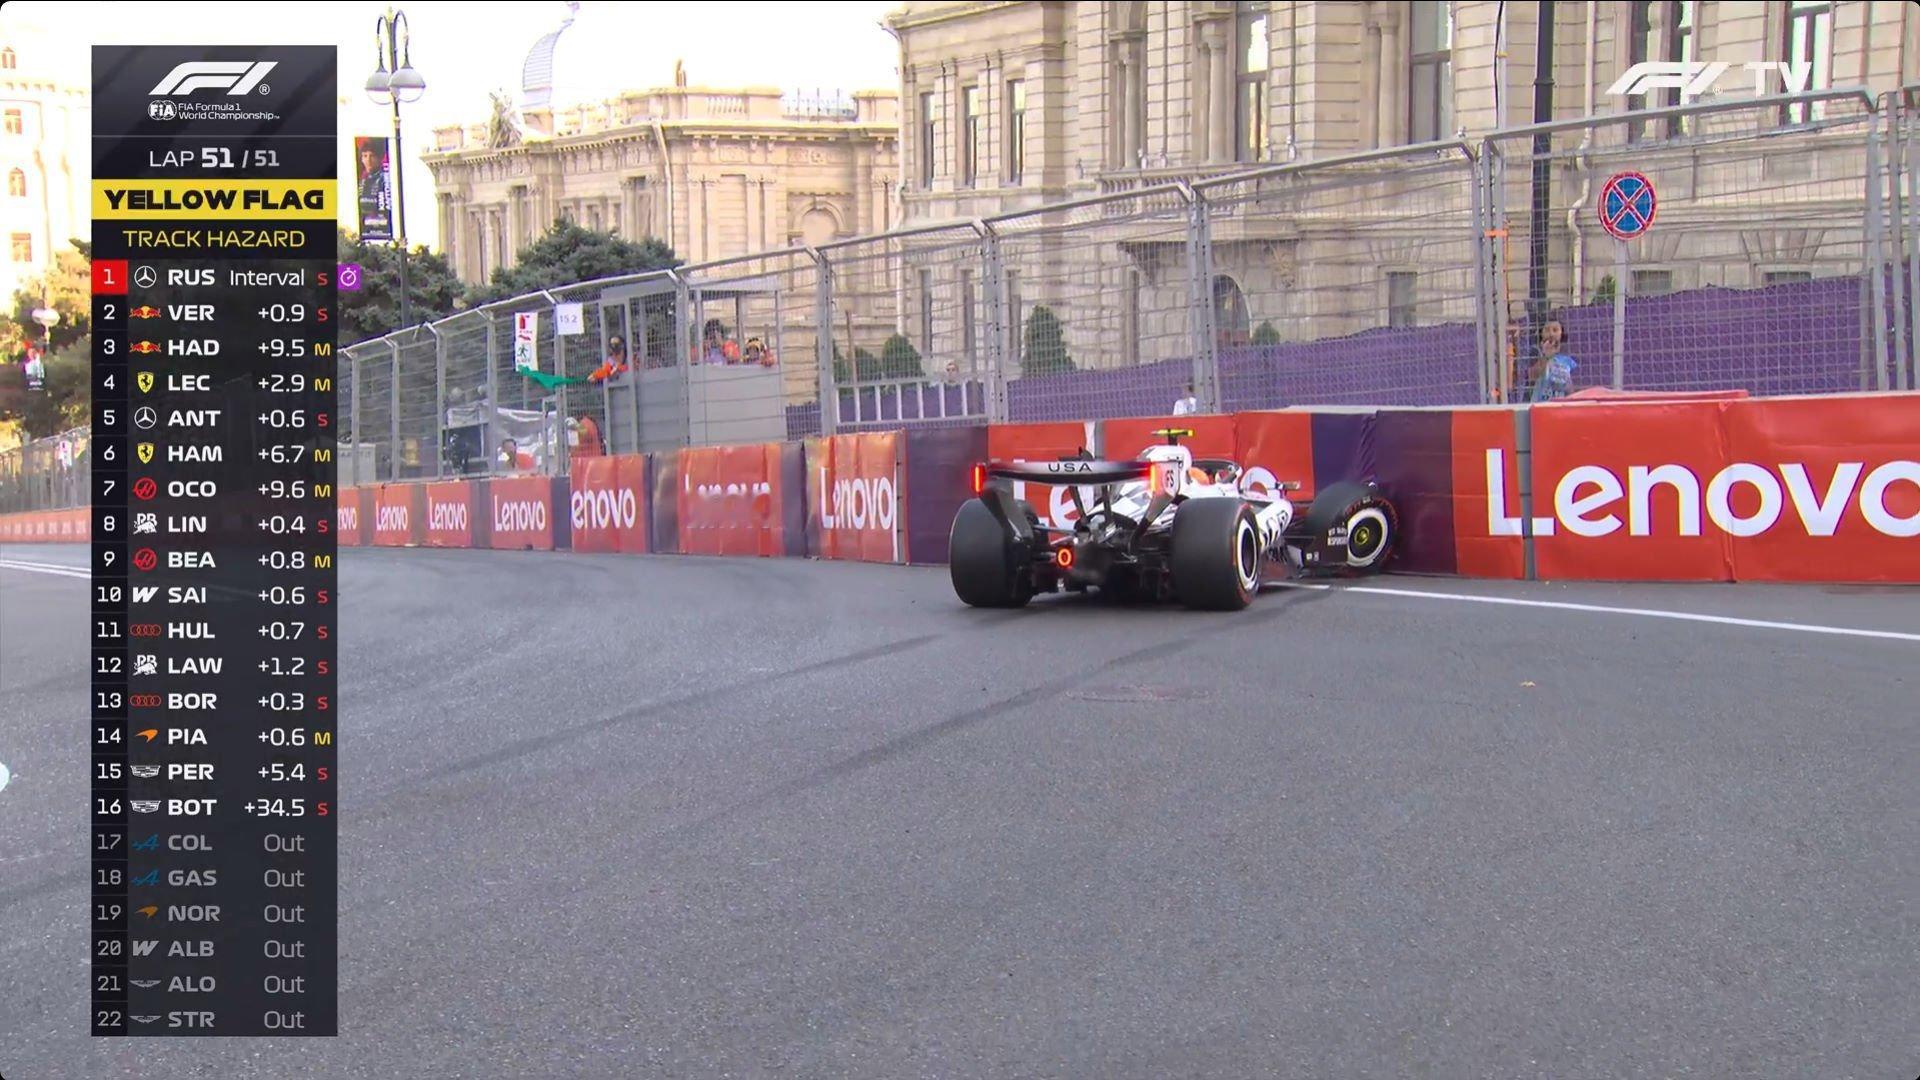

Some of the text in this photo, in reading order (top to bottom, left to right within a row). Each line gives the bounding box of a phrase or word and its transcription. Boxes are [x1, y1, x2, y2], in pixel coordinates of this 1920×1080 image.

[1048, 462, 1092, 473] USA
[820, 466, 893, 530] Lenovo
[1486, 448, 1920, 537] Lenovo
[376, 500, 409, 531] Lenovo
[429, 496, 468, 532] Lenovo
[494, 494, 546, 532] Lenovo
